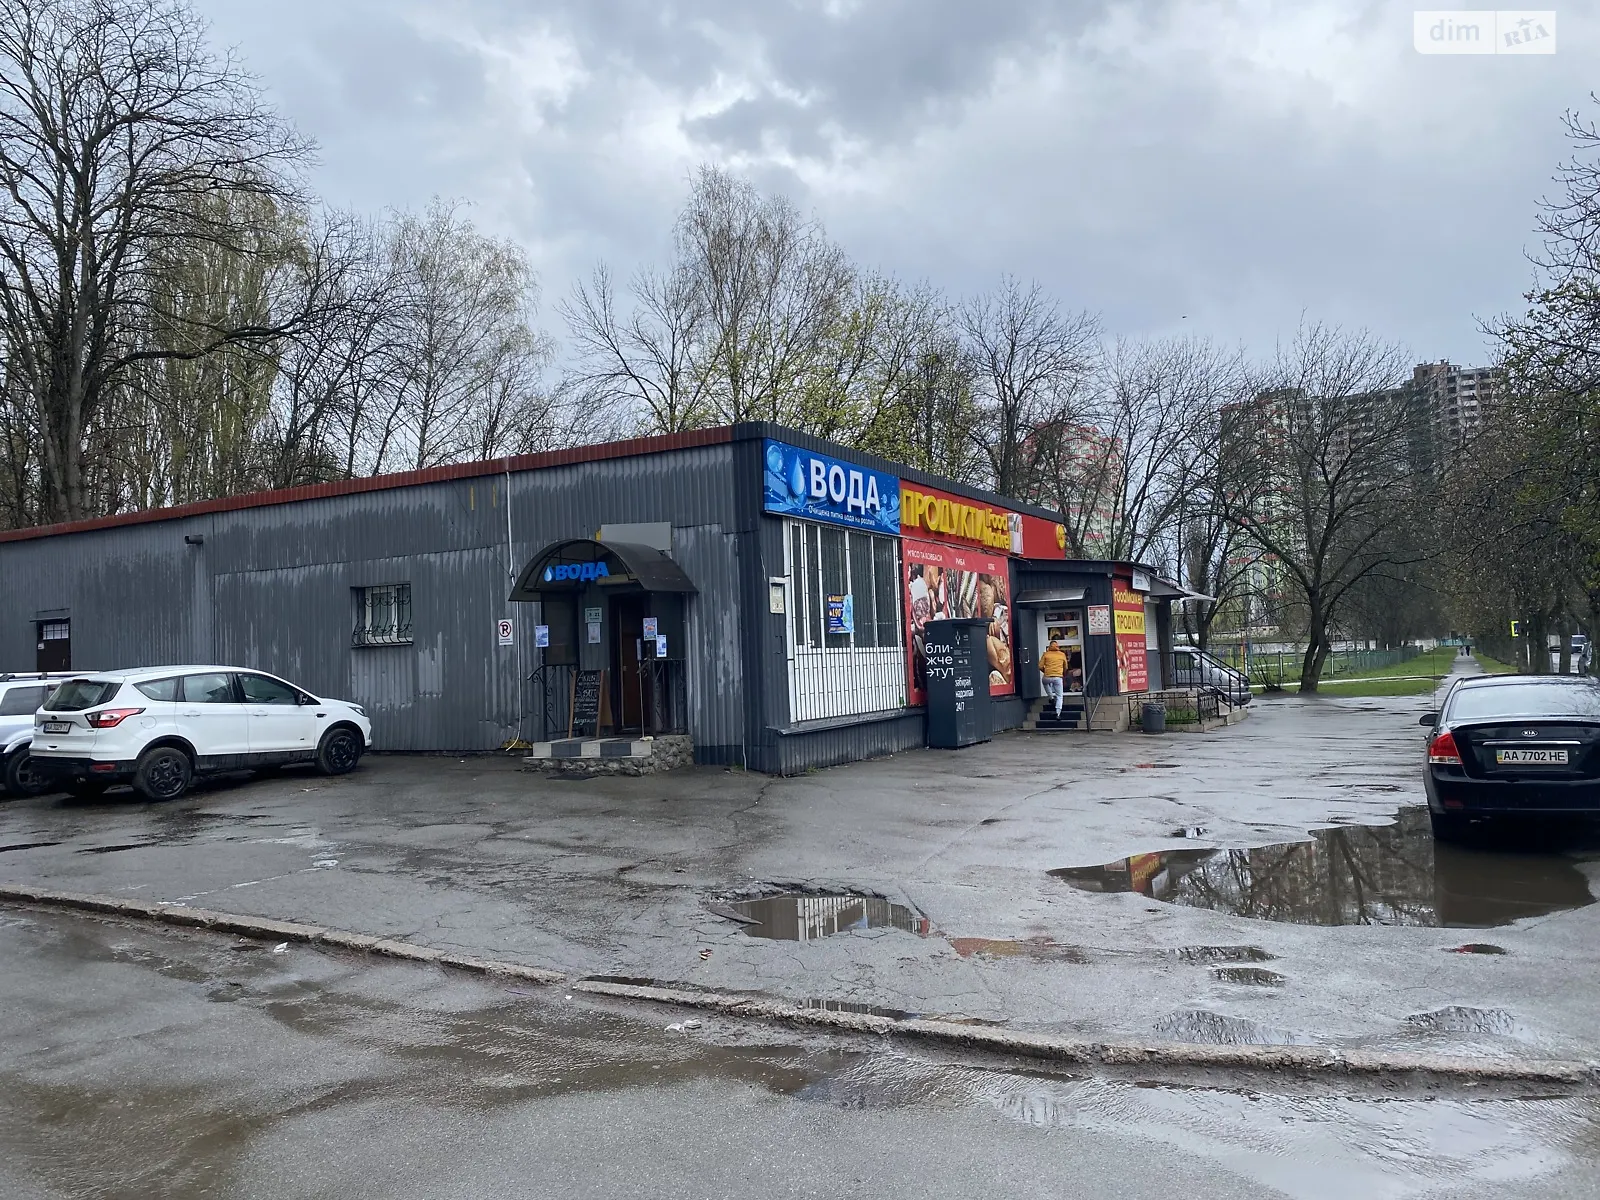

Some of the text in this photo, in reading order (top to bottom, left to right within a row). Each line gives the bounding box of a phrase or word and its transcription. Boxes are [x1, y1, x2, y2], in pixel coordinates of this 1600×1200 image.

[810, 459, 881, 515] ВОДА
[901, 488, 986, 541] ПРОДУКТИ
[986, 508, 1008, 530] Food
[555, 561, 609, 581] ВОДА
[1116, 614, 1144, 630] ПРОДУКТИ
[926, 655, 953, 666] жче
[933, 667, 954, 679] тут
[1503, 751, 1566, 761] AA 7702 HE
